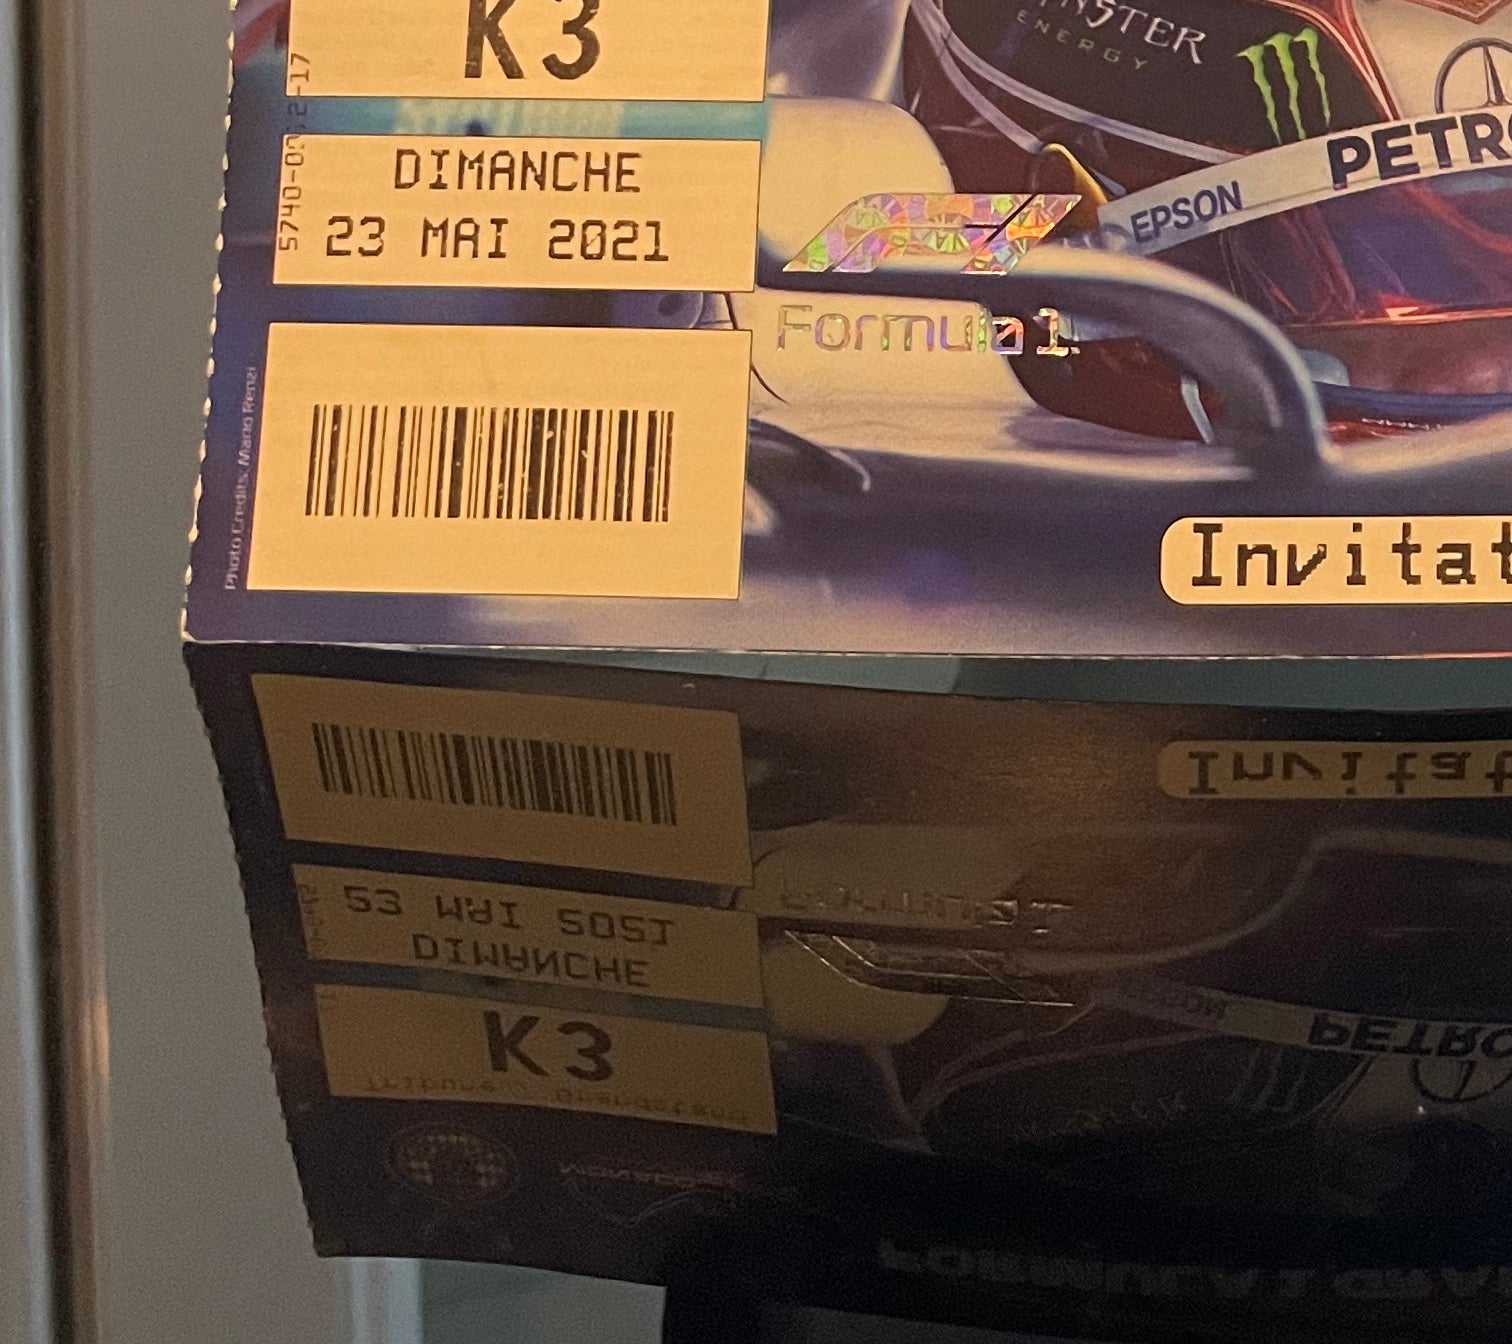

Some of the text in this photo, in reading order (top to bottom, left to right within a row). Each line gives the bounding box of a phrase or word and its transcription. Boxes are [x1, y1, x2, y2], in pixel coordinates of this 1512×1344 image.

[1016, 9, 1148, 70] ENERGY
[394, 148, 642, 193] DIMANCHE
[1131, 180, 1244, 244] EPSON
[326, 215, 669, 262] 23 MAI 2021
[224, 538, 242, 590] Photo
